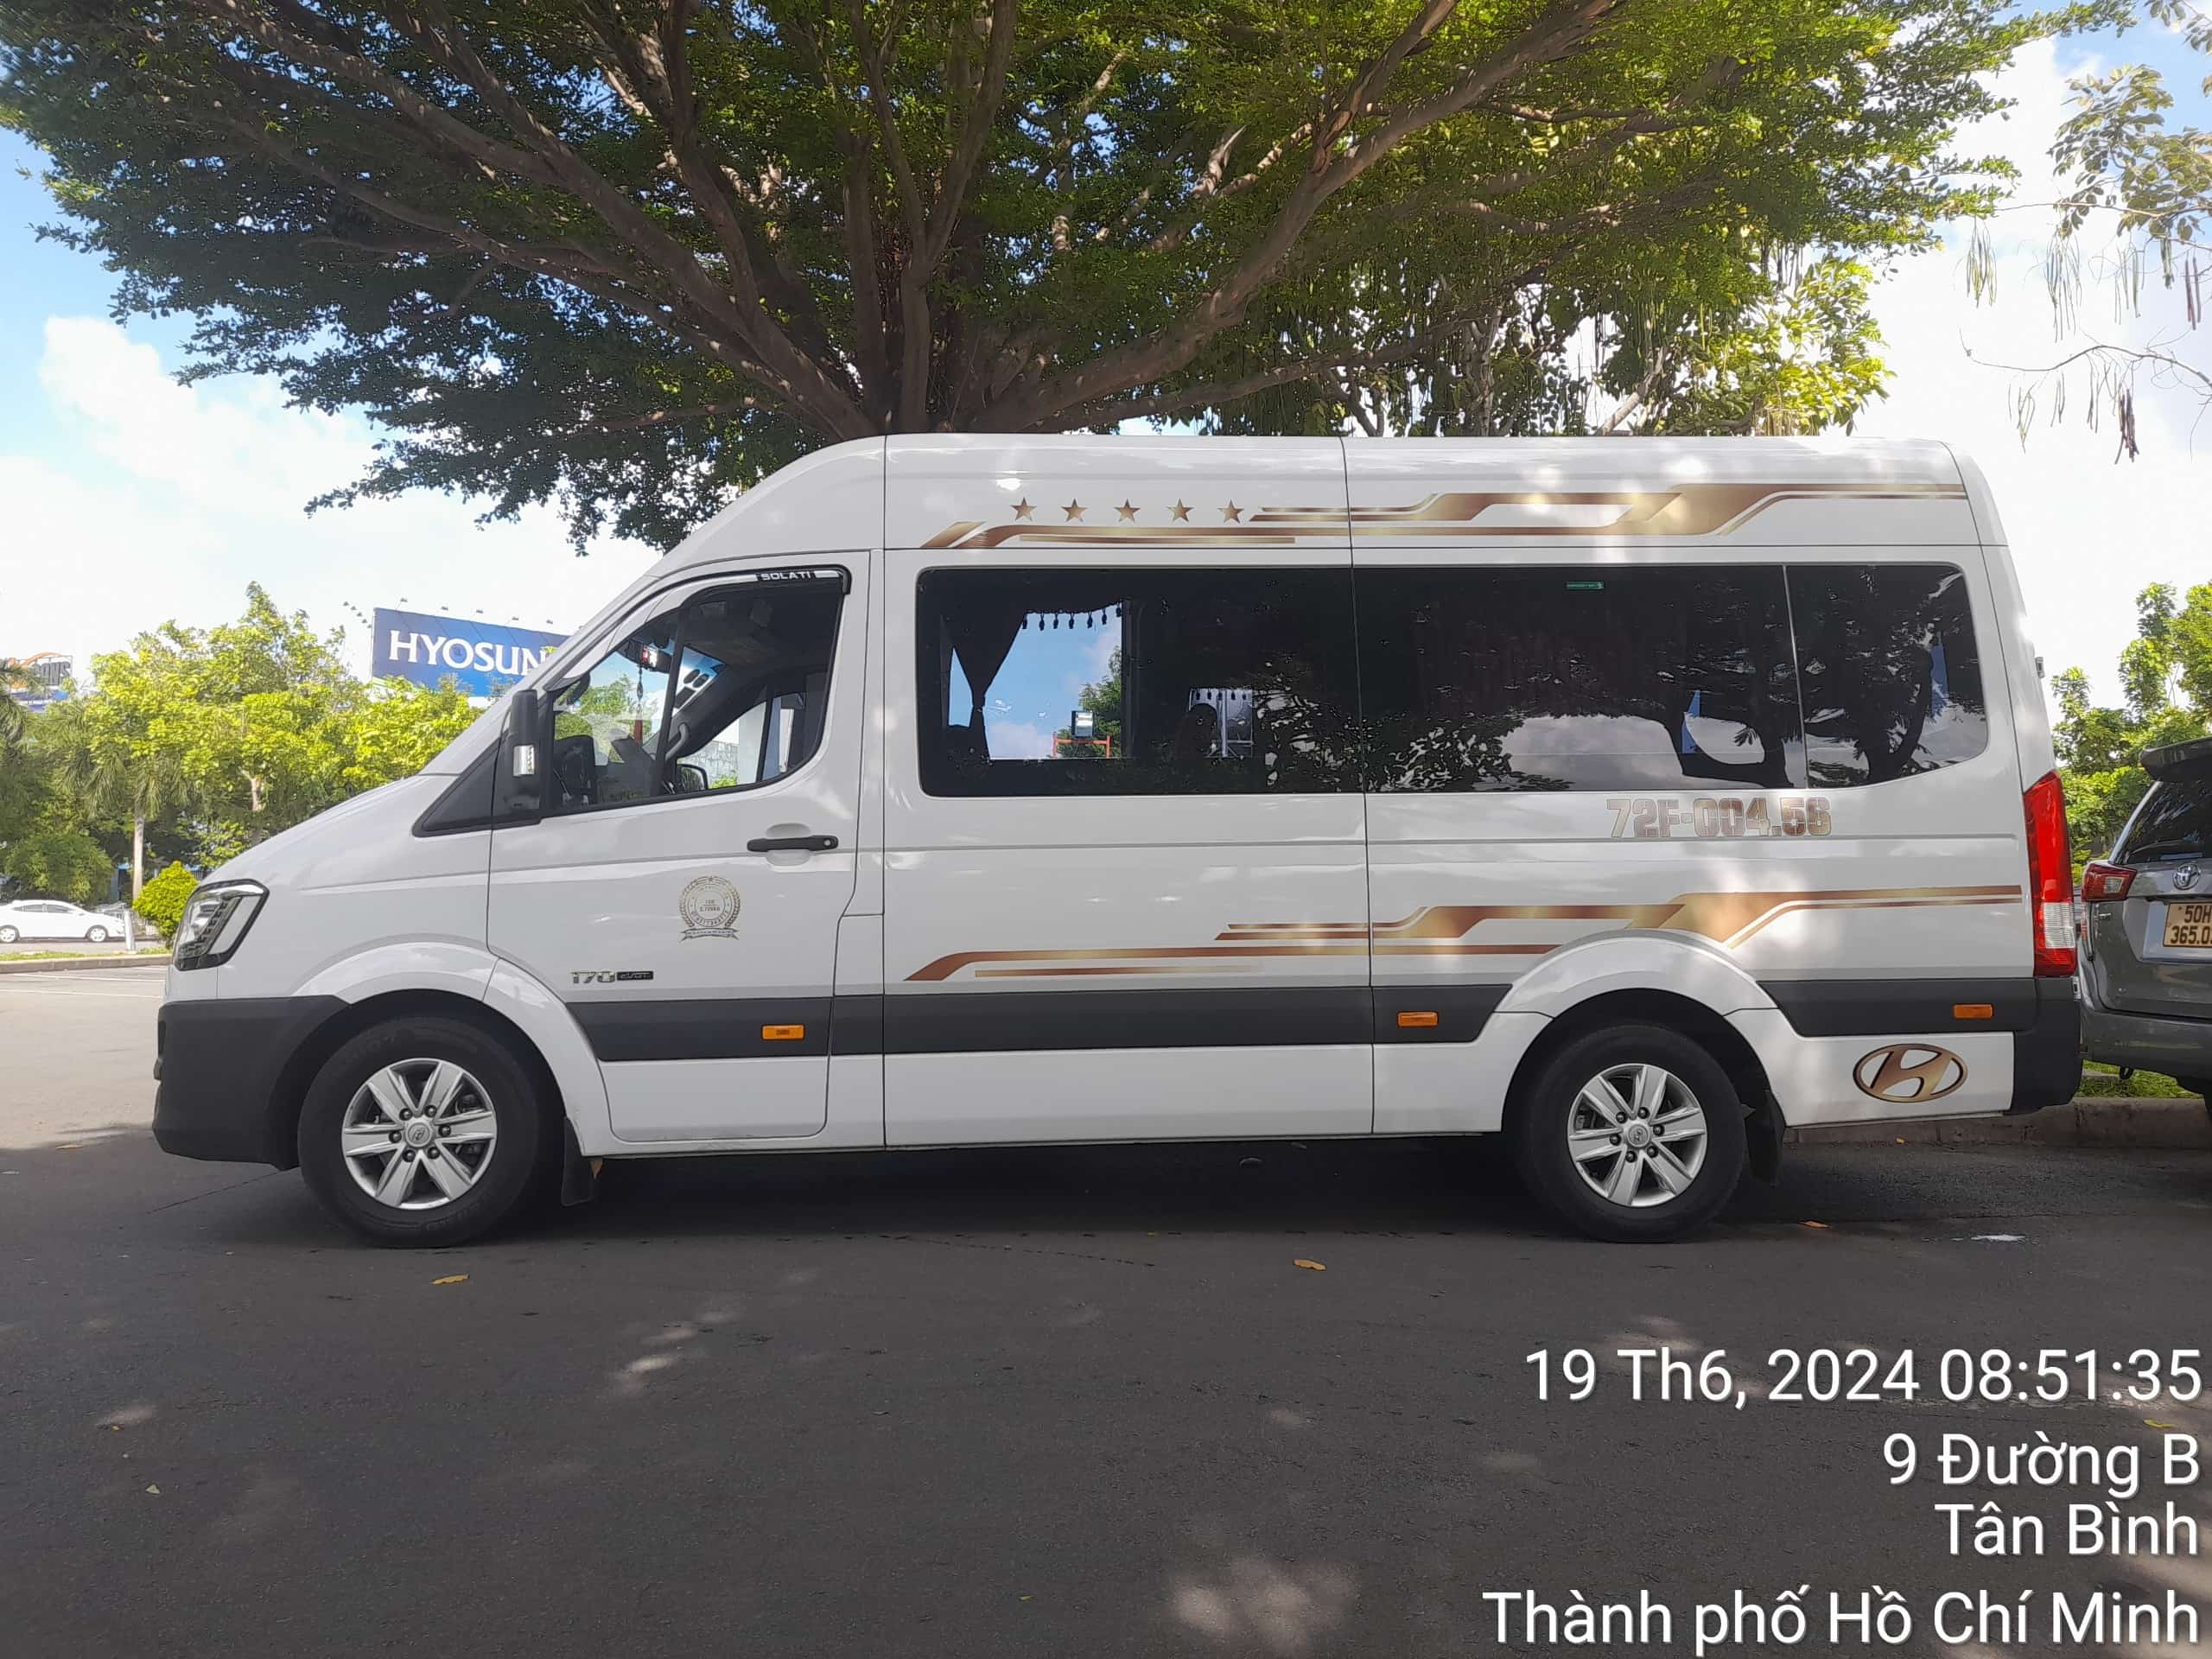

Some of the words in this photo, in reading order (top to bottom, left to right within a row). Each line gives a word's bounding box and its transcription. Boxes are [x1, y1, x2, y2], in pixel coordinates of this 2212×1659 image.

[760, 571, 811, 582] SOLATI
[1605, 798, 1833, 838] 72F-004.56
[2170, 925, 2212, 945] 365.0
[570, 970, 616, 984] 170
